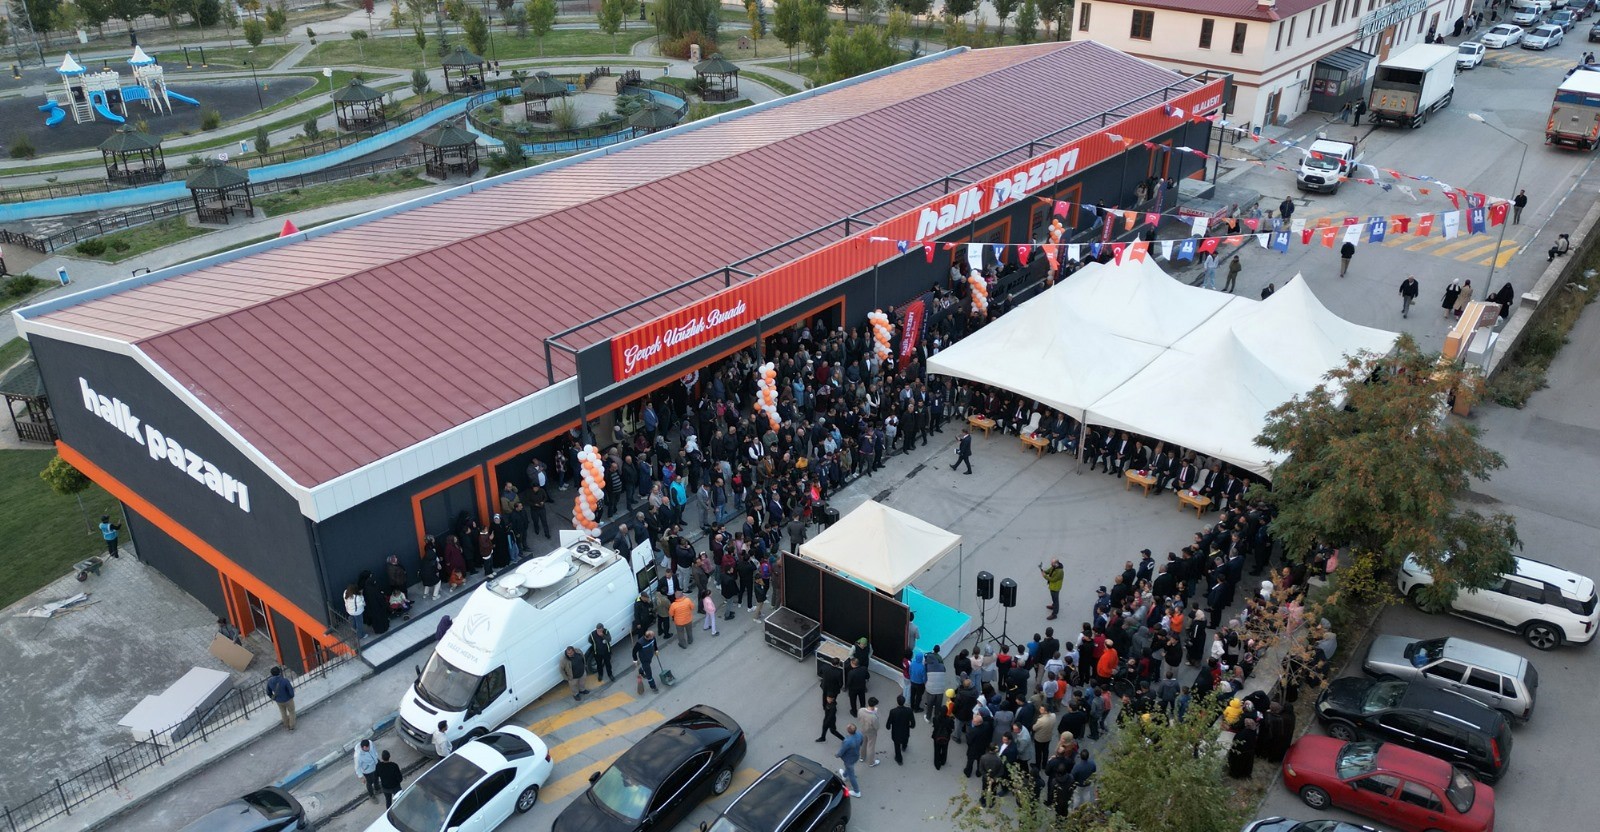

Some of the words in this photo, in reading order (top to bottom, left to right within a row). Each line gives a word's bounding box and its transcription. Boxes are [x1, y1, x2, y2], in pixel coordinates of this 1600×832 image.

[915, 186, 985, 241] halk
[990, 148, 1079, 210] pazarı
[624, 336, 662, 373] Gerçek
[705, 300, 747, 329] Burada
[79, 376, 145, 446] halk
[145, 424, 250, 513] pazarı
